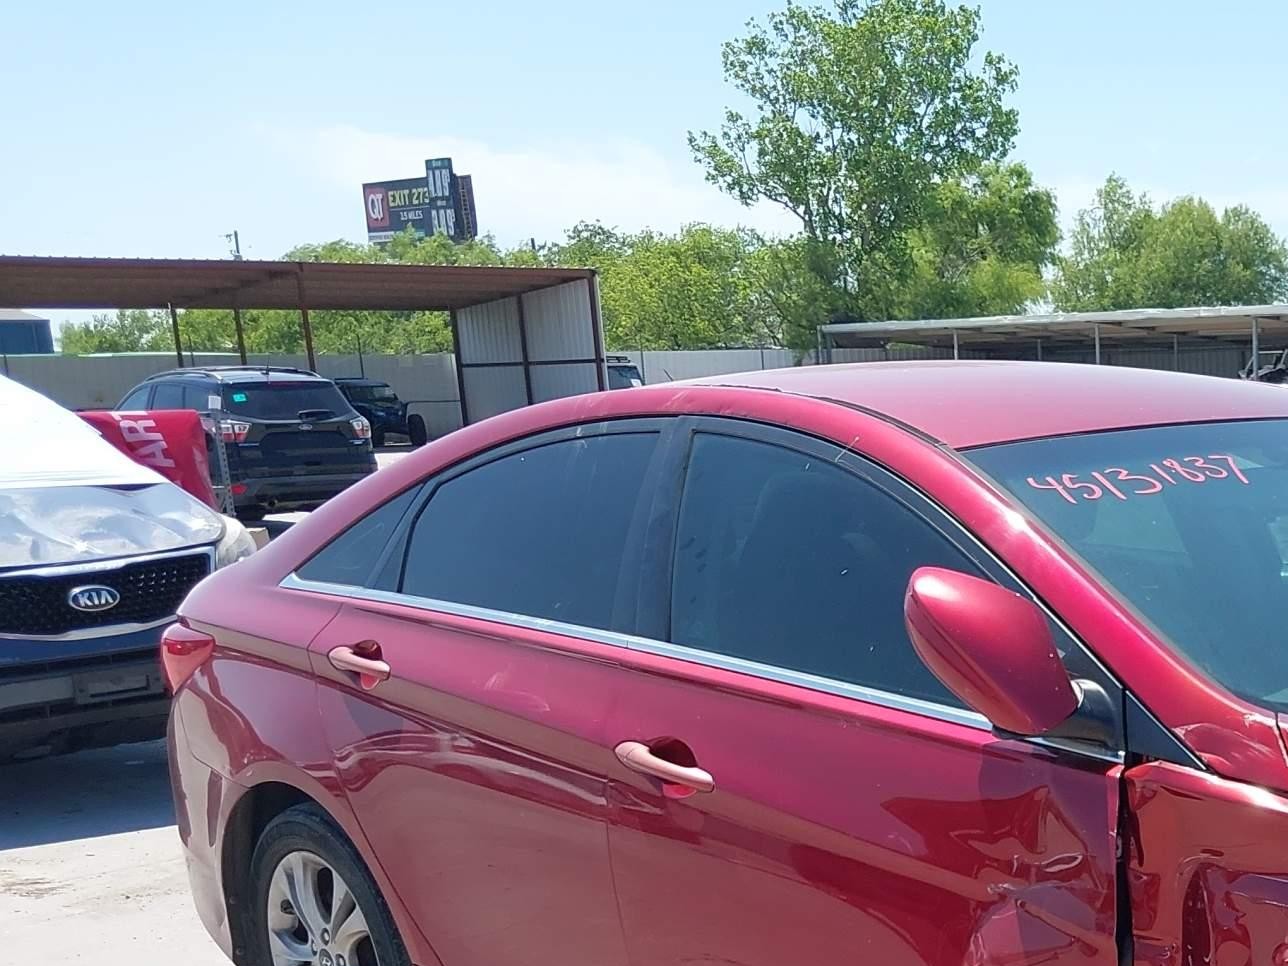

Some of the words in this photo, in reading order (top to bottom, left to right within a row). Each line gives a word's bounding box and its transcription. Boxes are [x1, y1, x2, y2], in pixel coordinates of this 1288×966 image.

[368, 193, 384, 220] QT
[388, 189, 409, 207] EXIT
[412, 187, 429, 204] 273
[1027, 452, 1249, 504] 45131837
[77, 590, 114, 607] KIA
